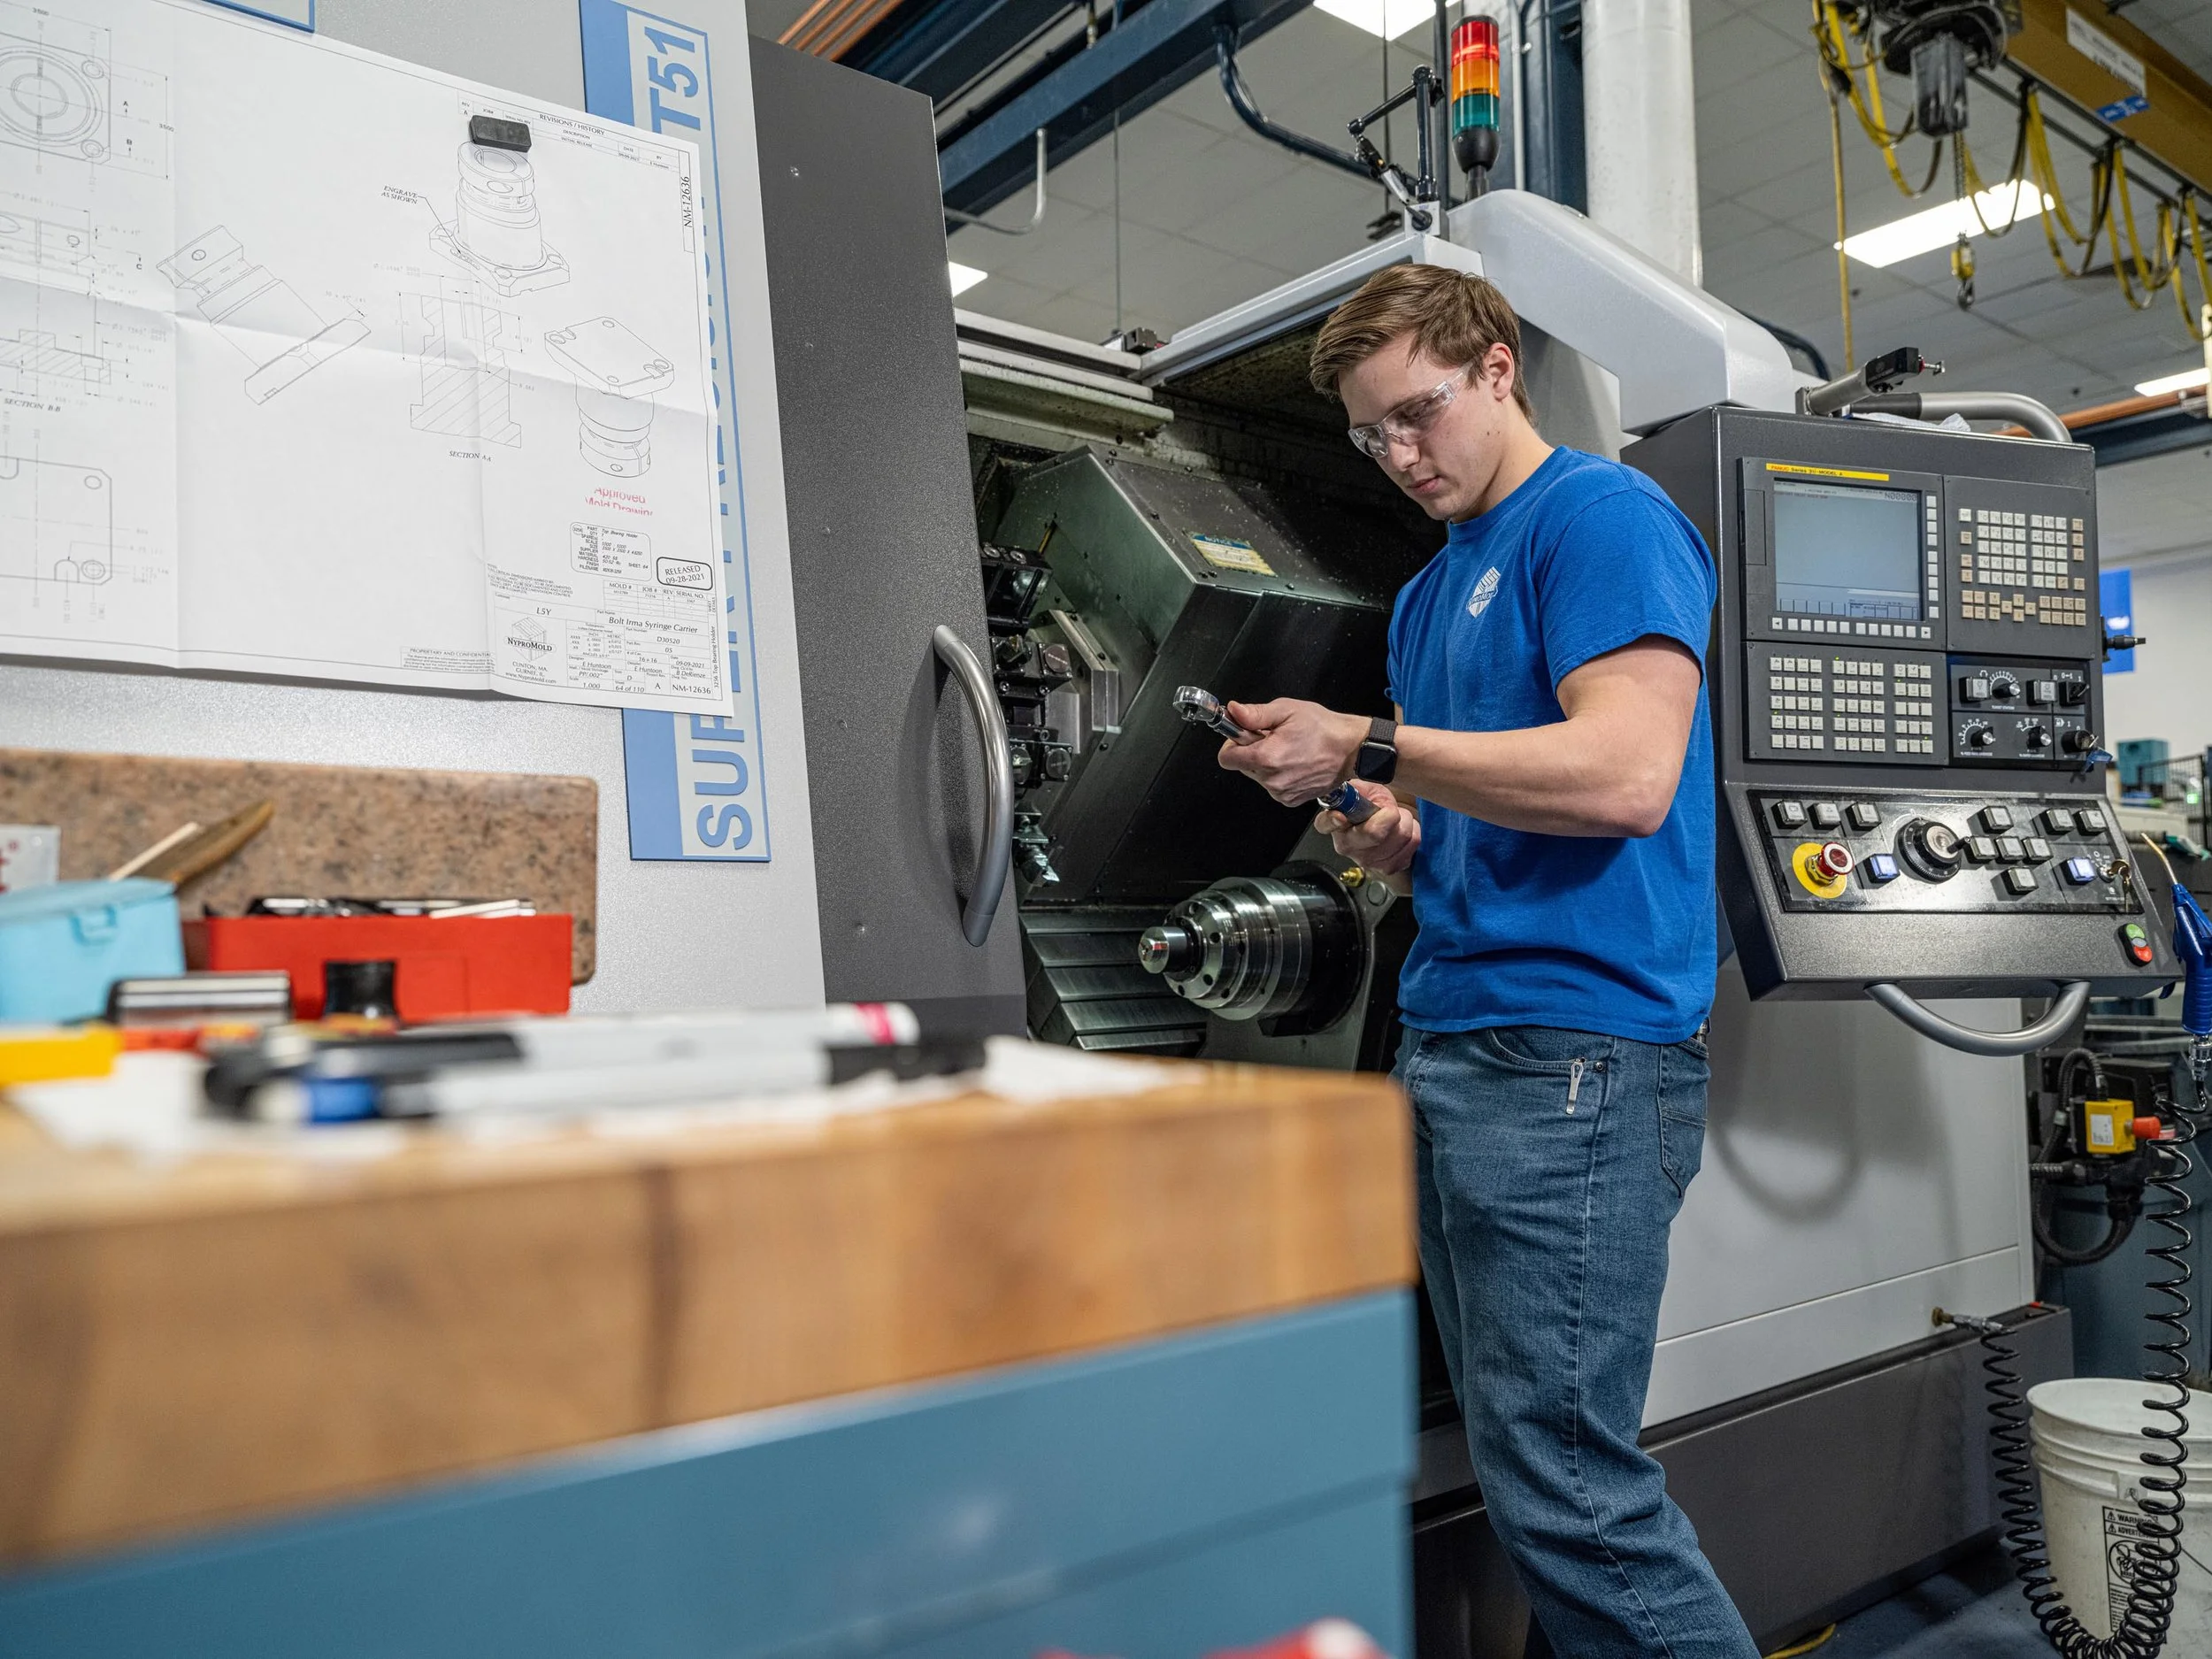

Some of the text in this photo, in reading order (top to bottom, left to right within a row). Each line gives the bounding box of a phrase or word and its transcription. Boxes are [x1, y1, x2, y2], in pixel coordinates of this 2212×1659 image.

[644, 26, 701, 134] T51
[539, 114, 573, 127] REVISIONS
[577, 124, 605, 135] HISTORY
[563, 129, 590, 140] DESCRIPTION
[383, 185, 419, 199] ENGRAVE
[390, 193, 418, 204] SHOWN
[680, 176, 693, 228] NM-12636
[4, 396, 44, 411] SECTION
[449, 449, 480, 459] SECTION
[664, 565, 701, 576] RELEASED
[665, 572, 705, 585] 09-28-2021
[609, 616, 698, 634] Bolt Irma Syringe Carrier
[657, 635, 680, 645] D30520
[587, 661, 611, 670] Huntoon
[675, 660, 704, 669] 09-09-2021
[505, 672, 557, 684] www.NyproMold.com
[672, 684, 711, 695] NM-12636
